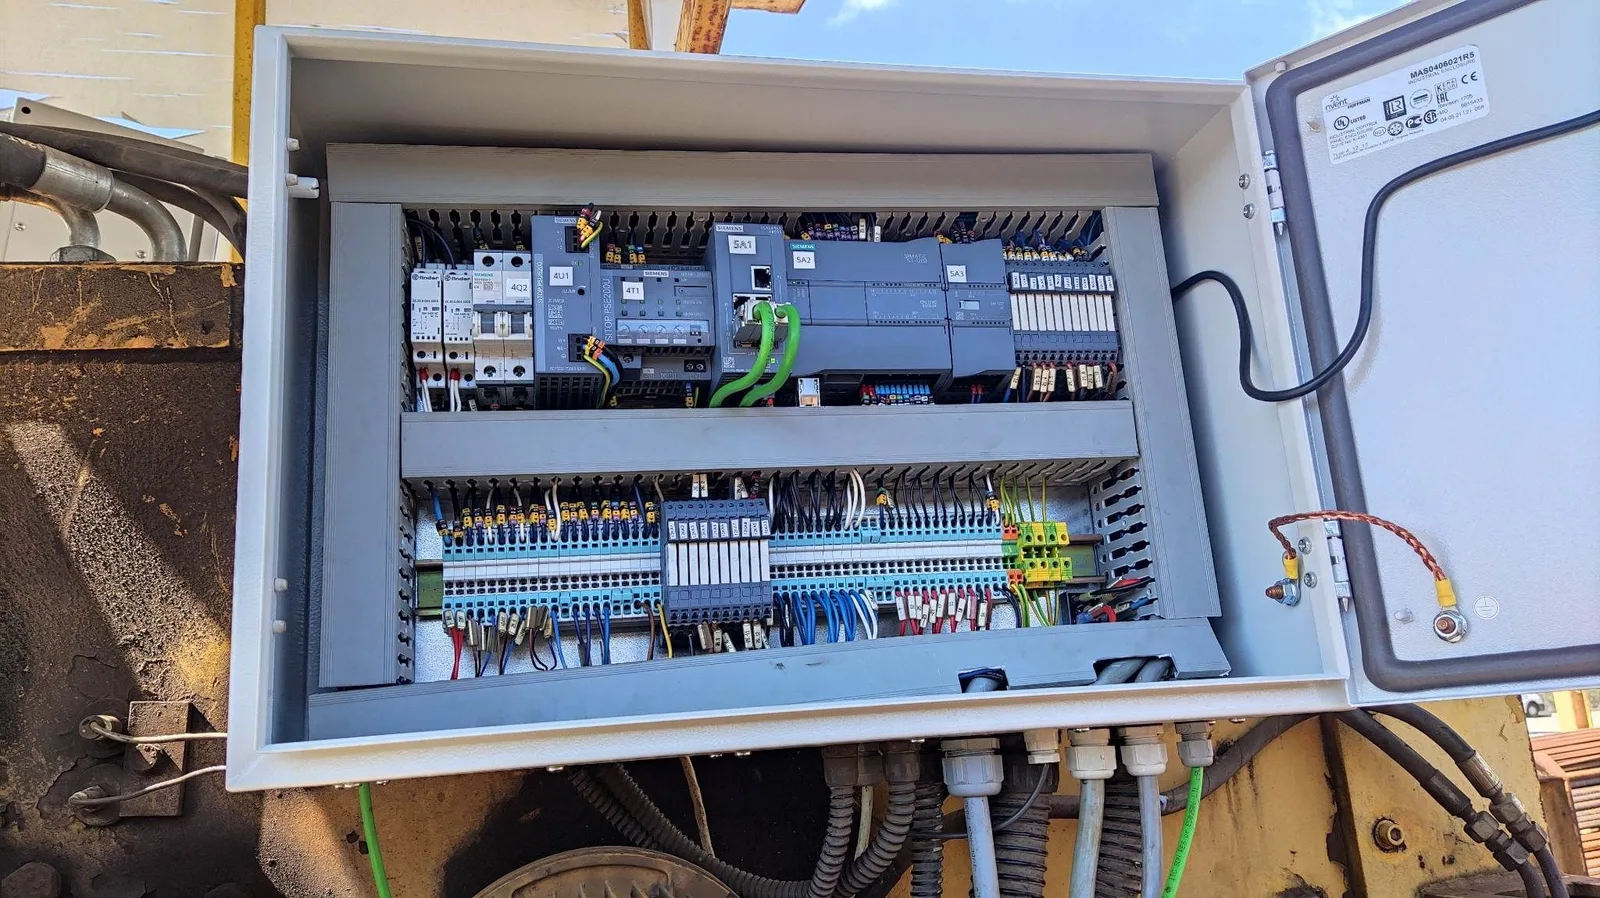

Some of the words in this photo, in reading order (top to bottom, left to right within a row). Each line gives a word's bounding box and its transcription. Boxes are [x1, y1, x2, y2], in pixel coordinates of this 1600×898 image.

[1410, 51, 1475, 79] MAS0406021R5
[1351, 115, 1366, 124] LISTED
[733, 240, 752, 249] 5A1
[511, 284, 528, 292] 4Q2
[626, 286, 639, 294] 4T1
